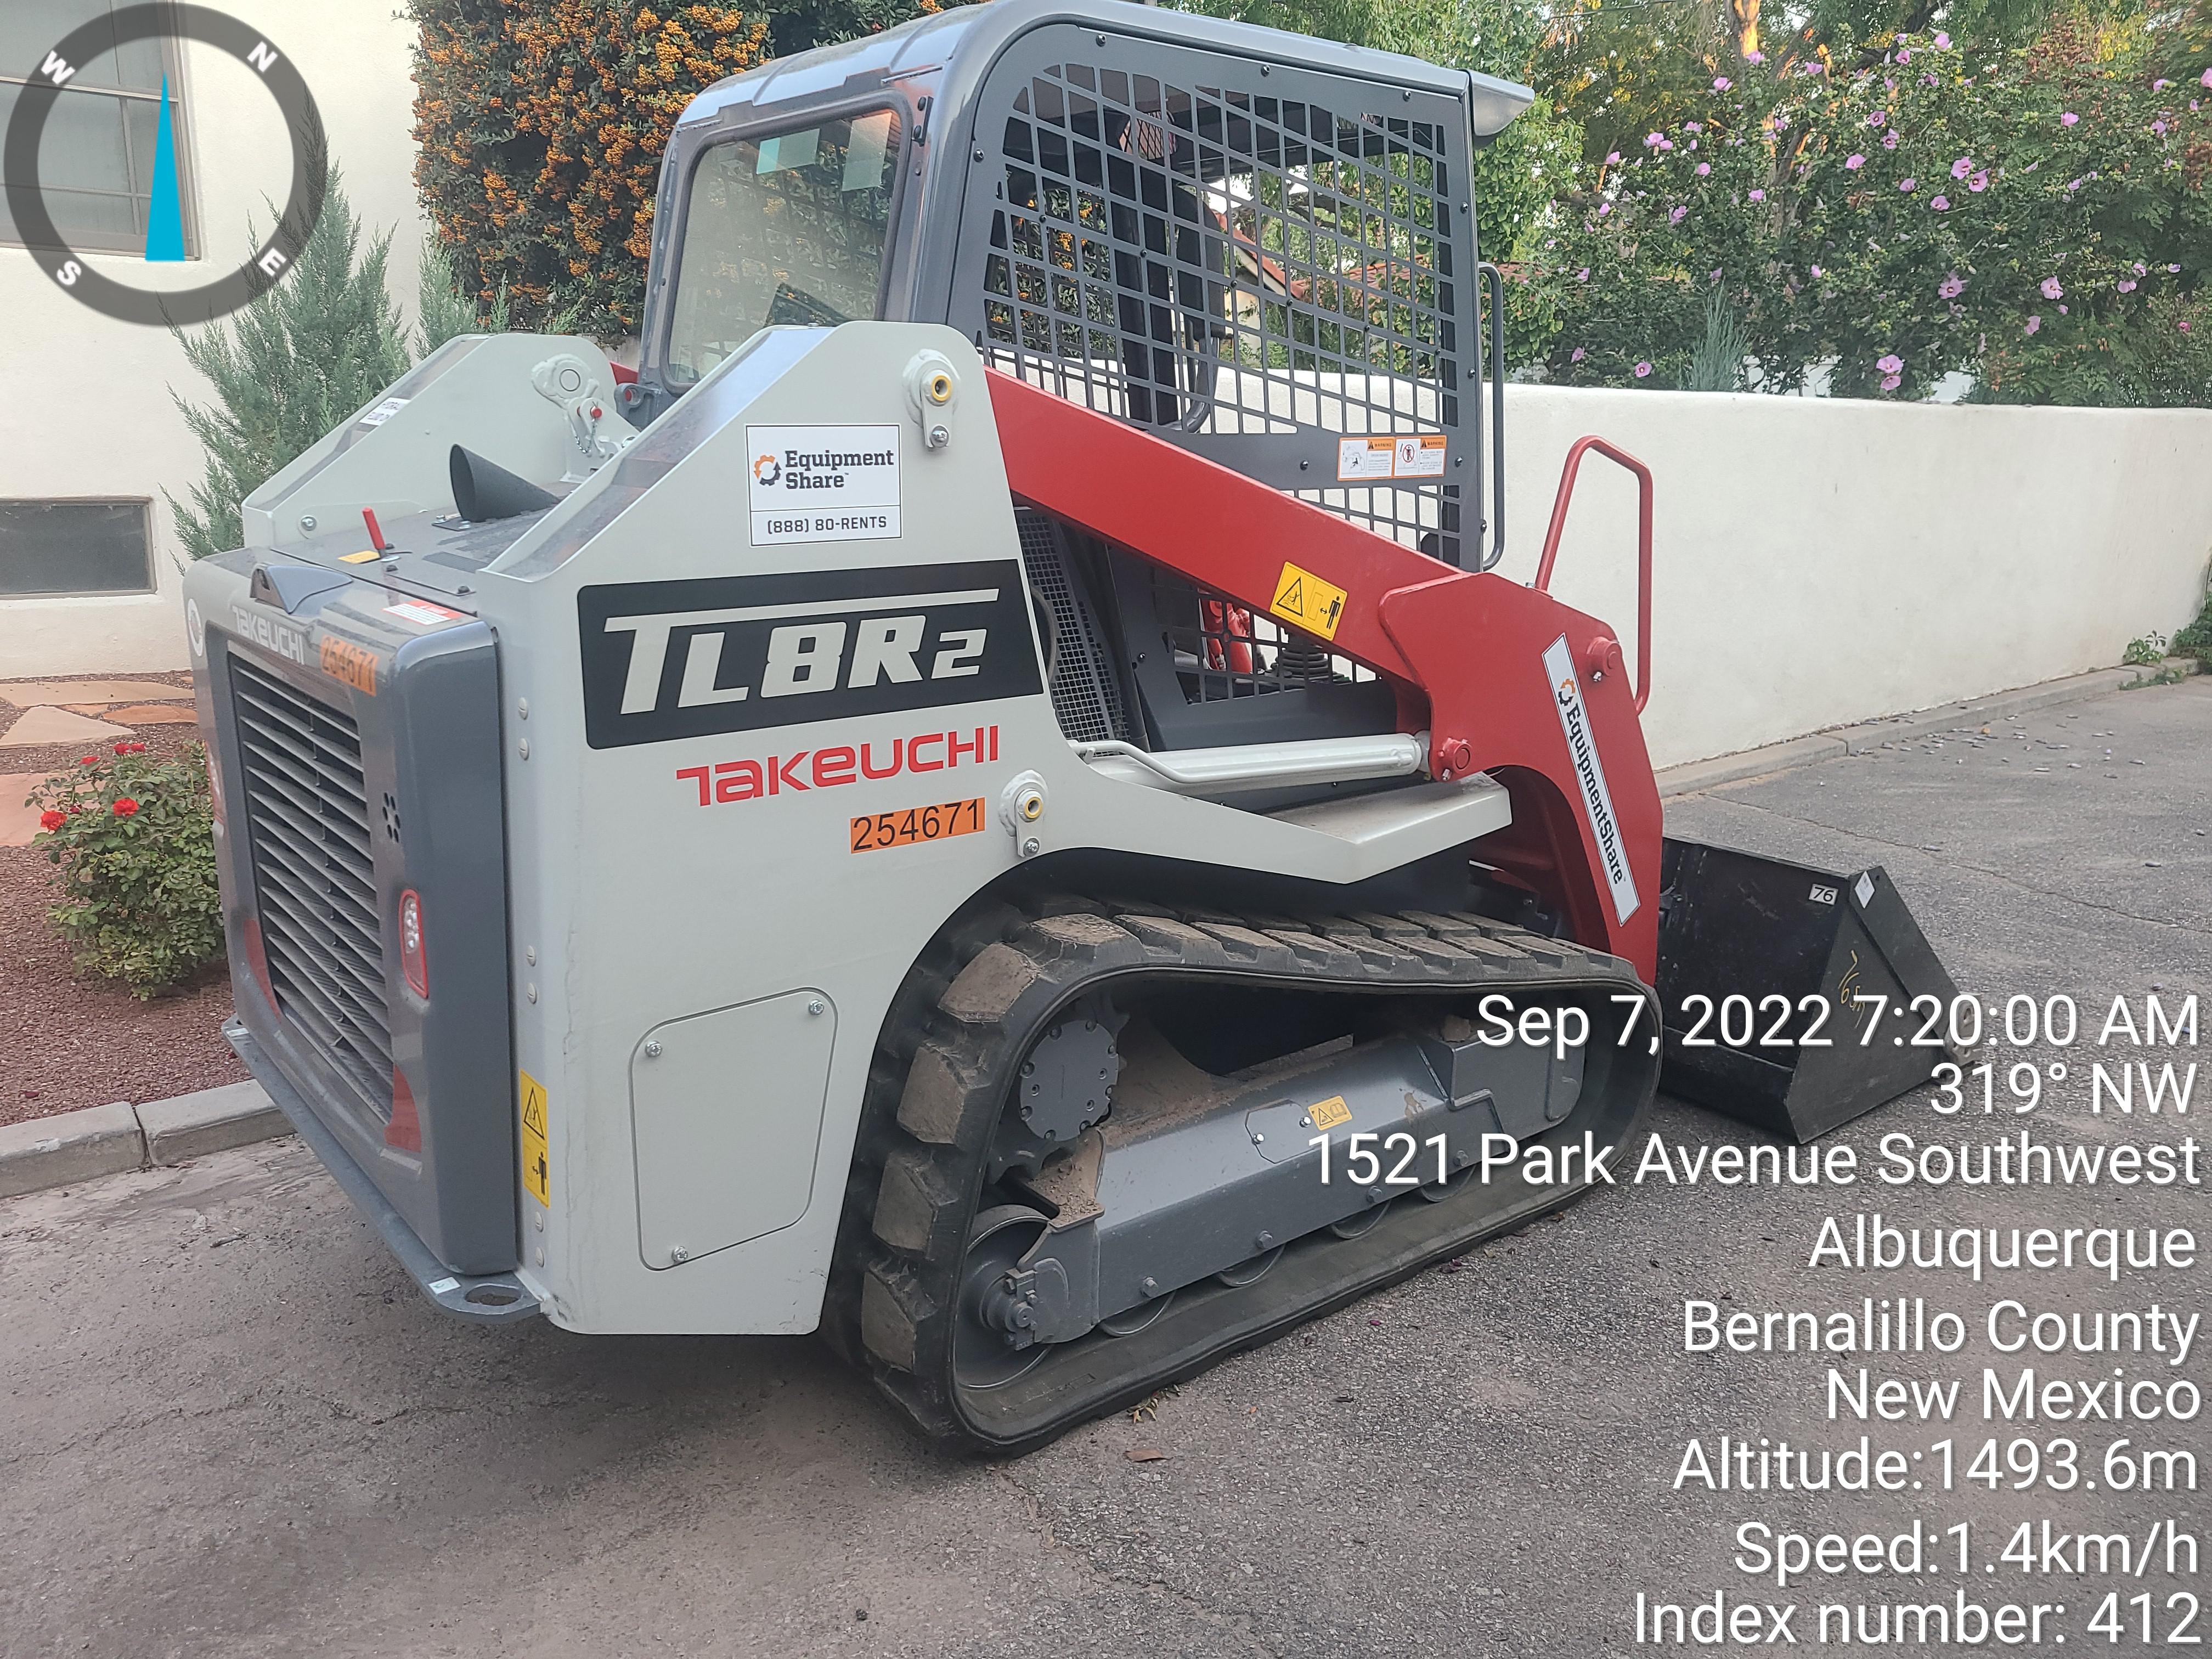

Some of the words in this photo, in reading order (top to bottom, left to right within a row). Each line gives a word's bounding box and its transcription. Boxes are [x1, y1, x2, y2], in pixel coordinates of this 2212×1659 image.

[785, 449, 895, 471] Equipment
[786, 471, 845, 490] Share
[768, 518, 809, 534] (888)
[321, 636, 375, 693] 254671
[603, 588, 1000, 715] TL8R2
[1566, 702, 1624, 885] EquipmentShare
[853, 799, 978, 850] 254671
[1813, 886, 1833, 902] 76
